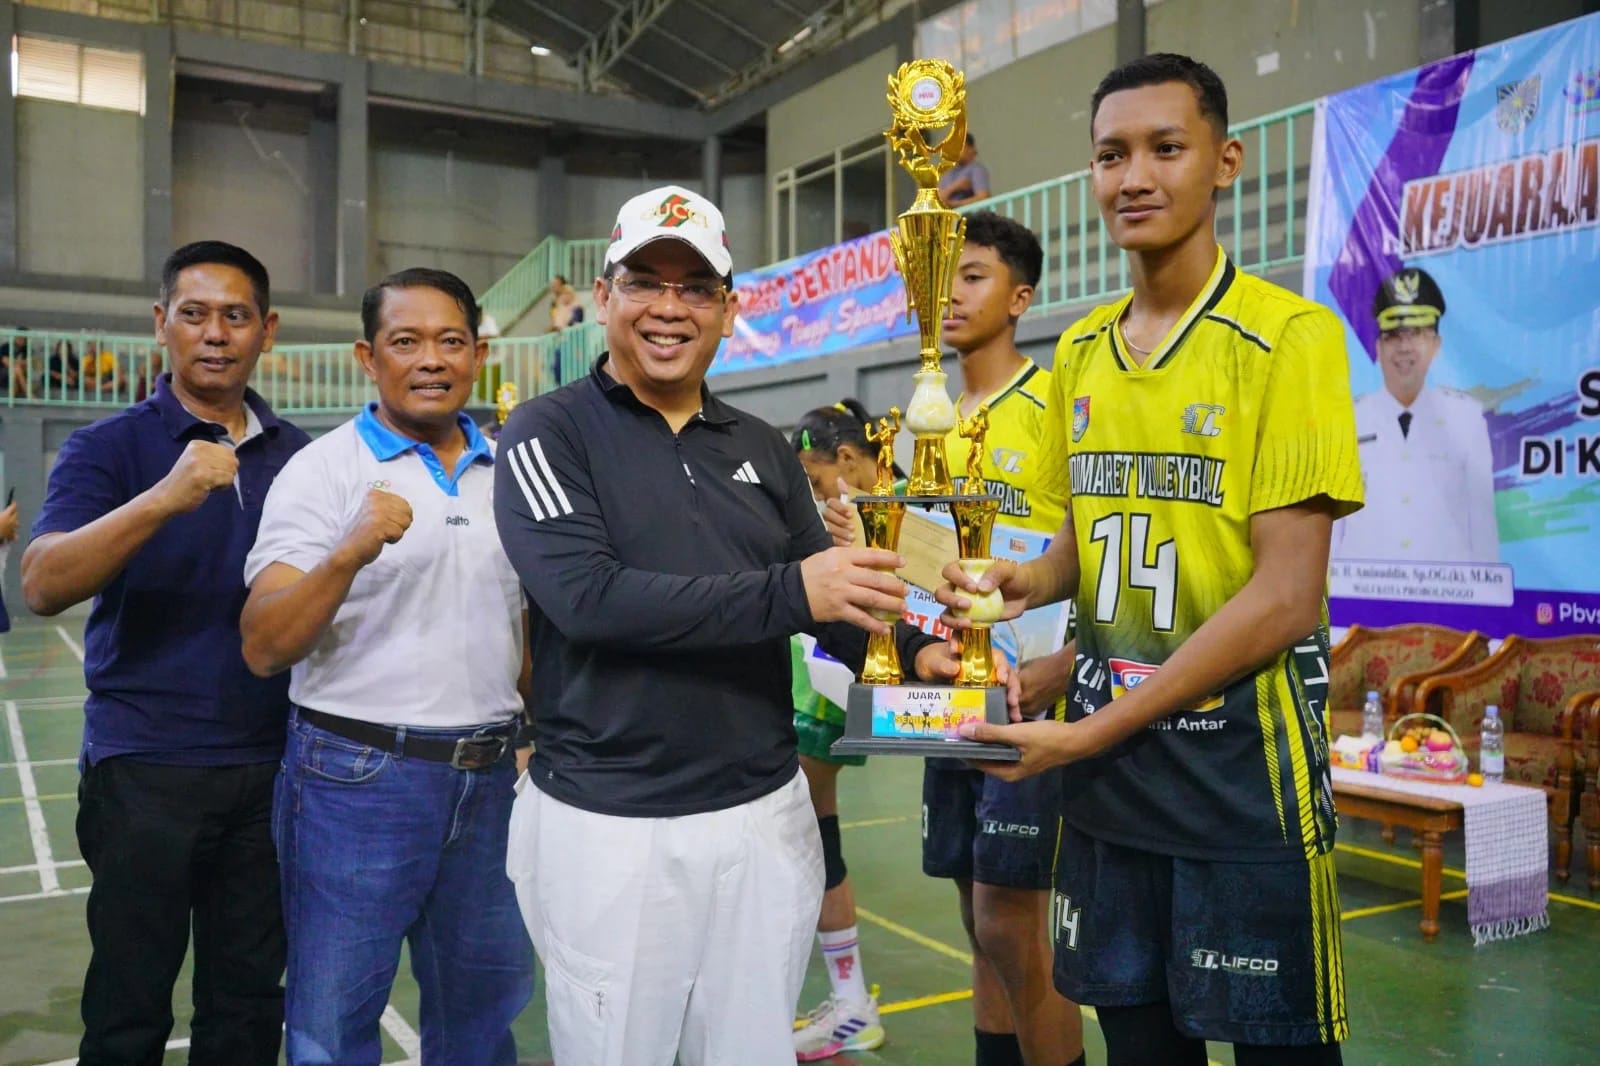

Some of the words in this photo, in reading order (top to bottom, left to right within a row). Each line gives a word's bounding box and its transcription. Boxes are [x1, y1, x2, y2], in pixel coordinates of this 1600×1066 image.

[1522, 438, 1562, 475] DI
[1136, 452, 1225, 506] VOLLEYBALL
[1090, 512, 1178, 632] 14
[907, 691, 941, 700] JUARA
[1177, 716, 1227, 731] Antar
[998, 822, 1040, 836] LIFCO
[1221, 954, 1279, 971] LIFCO
